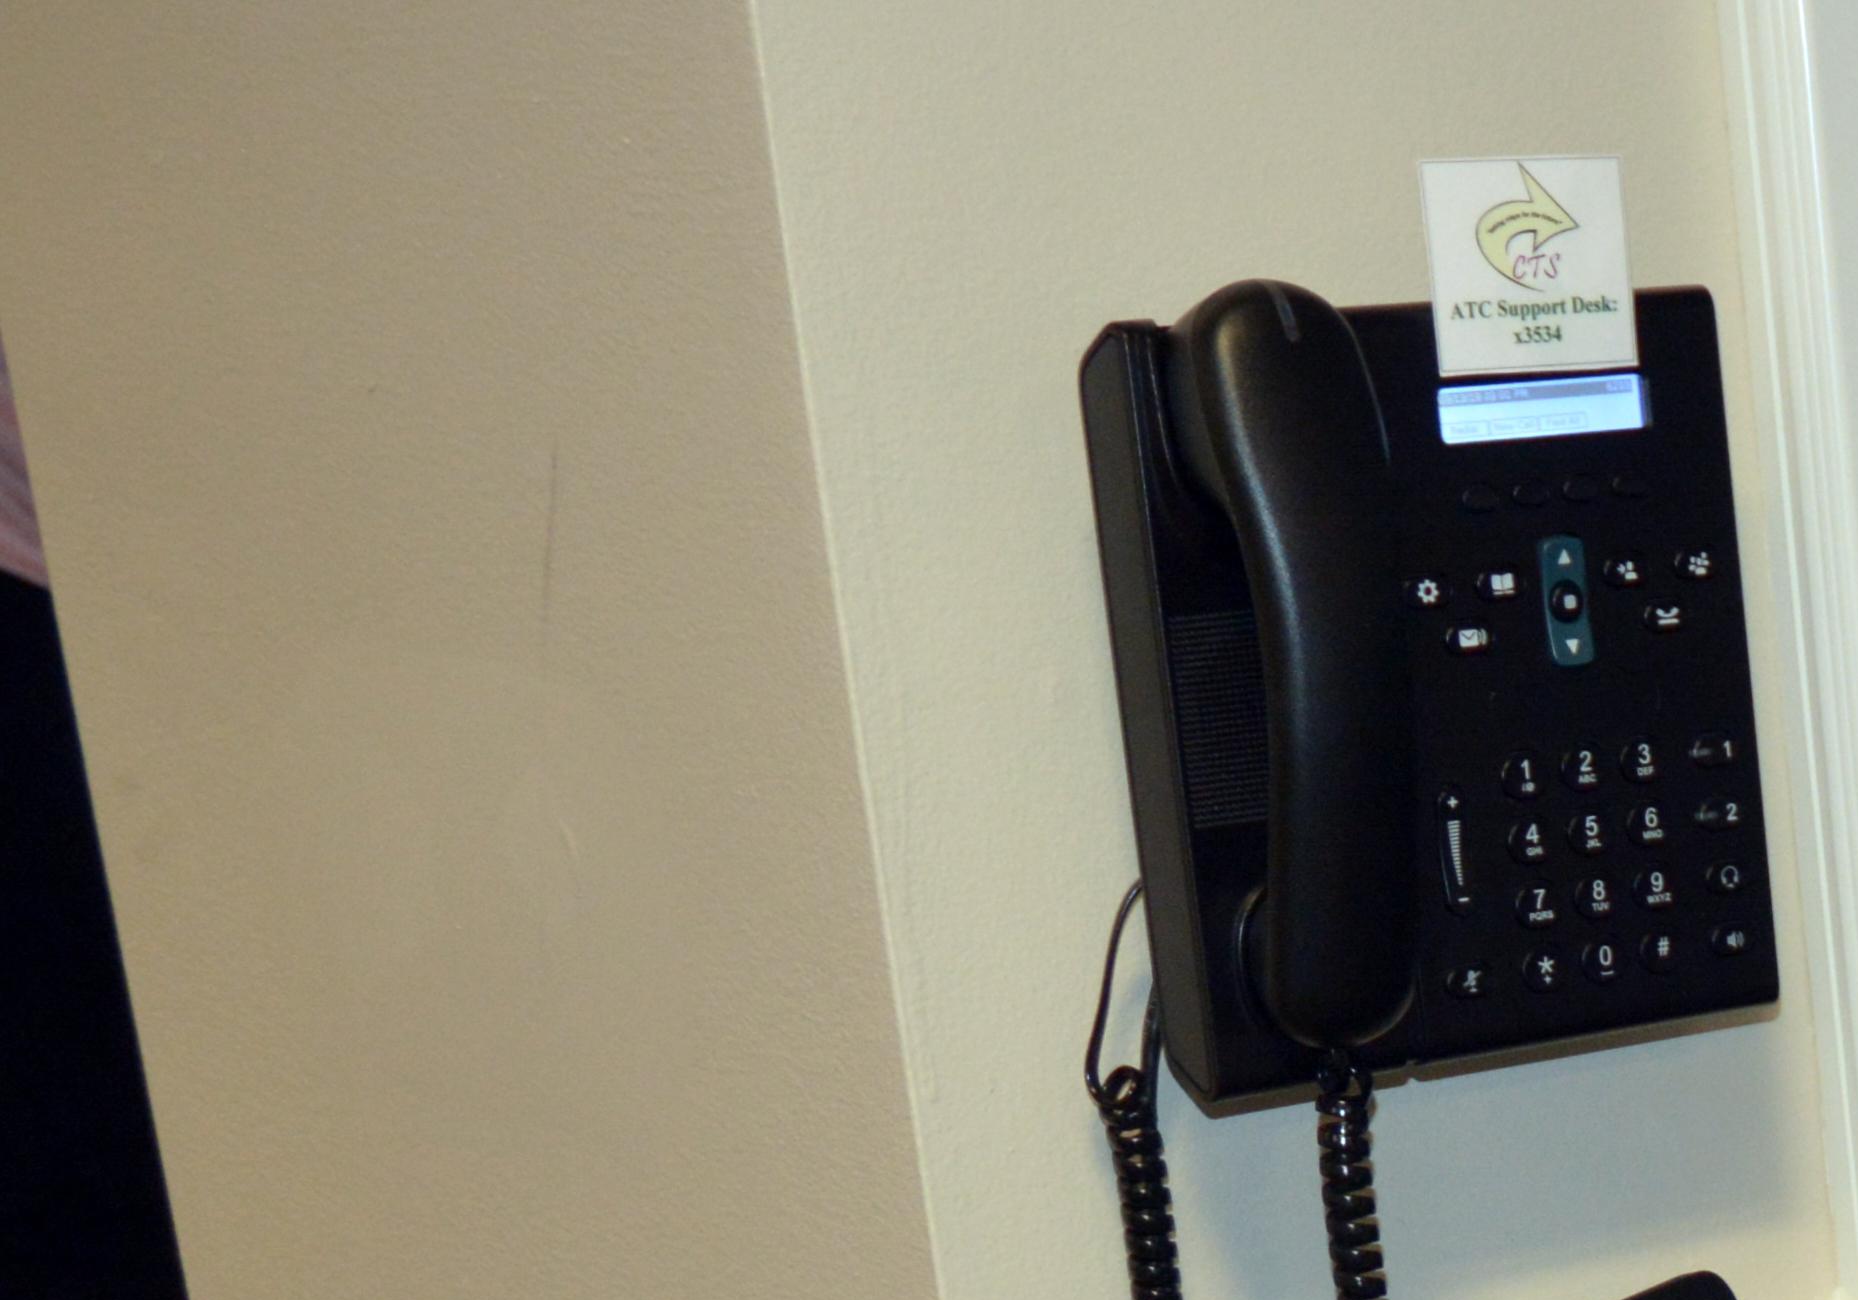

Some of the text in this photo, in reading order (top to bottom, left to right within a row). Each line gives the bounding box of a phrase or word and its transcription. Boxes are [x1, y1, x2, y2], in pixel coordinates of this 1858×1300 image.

[1512, 252, 1562, 280] CTS
[1450, 295, 1619, 322] ATC Support Desk:
[1513, 325, 1563, 345] x3534
[1637, 743, 1651, 764] 3
[1722, 741, 1733, 759] 1
[1520, 759, 1531, 780] 1
[1578, 751, 1593, 772] 2
[1636, 766, 1655, 776] DEF
[1578, 774, 1598, 784] ABC
[1644, 807, 1658, 828] 6
[1725, 803, 1739, 821] 2
[1525, 823, 1541, 844] 4
[1585, 815, 1599, 837] 5
[1592, 879, 1606, 901] 8
[1650, 871, 1664, 893] 9
[1533, 888, 1546, 910] 7
[1591, 902, 1610, 912] TUV
[1599, 945, 1612, 966] 0
